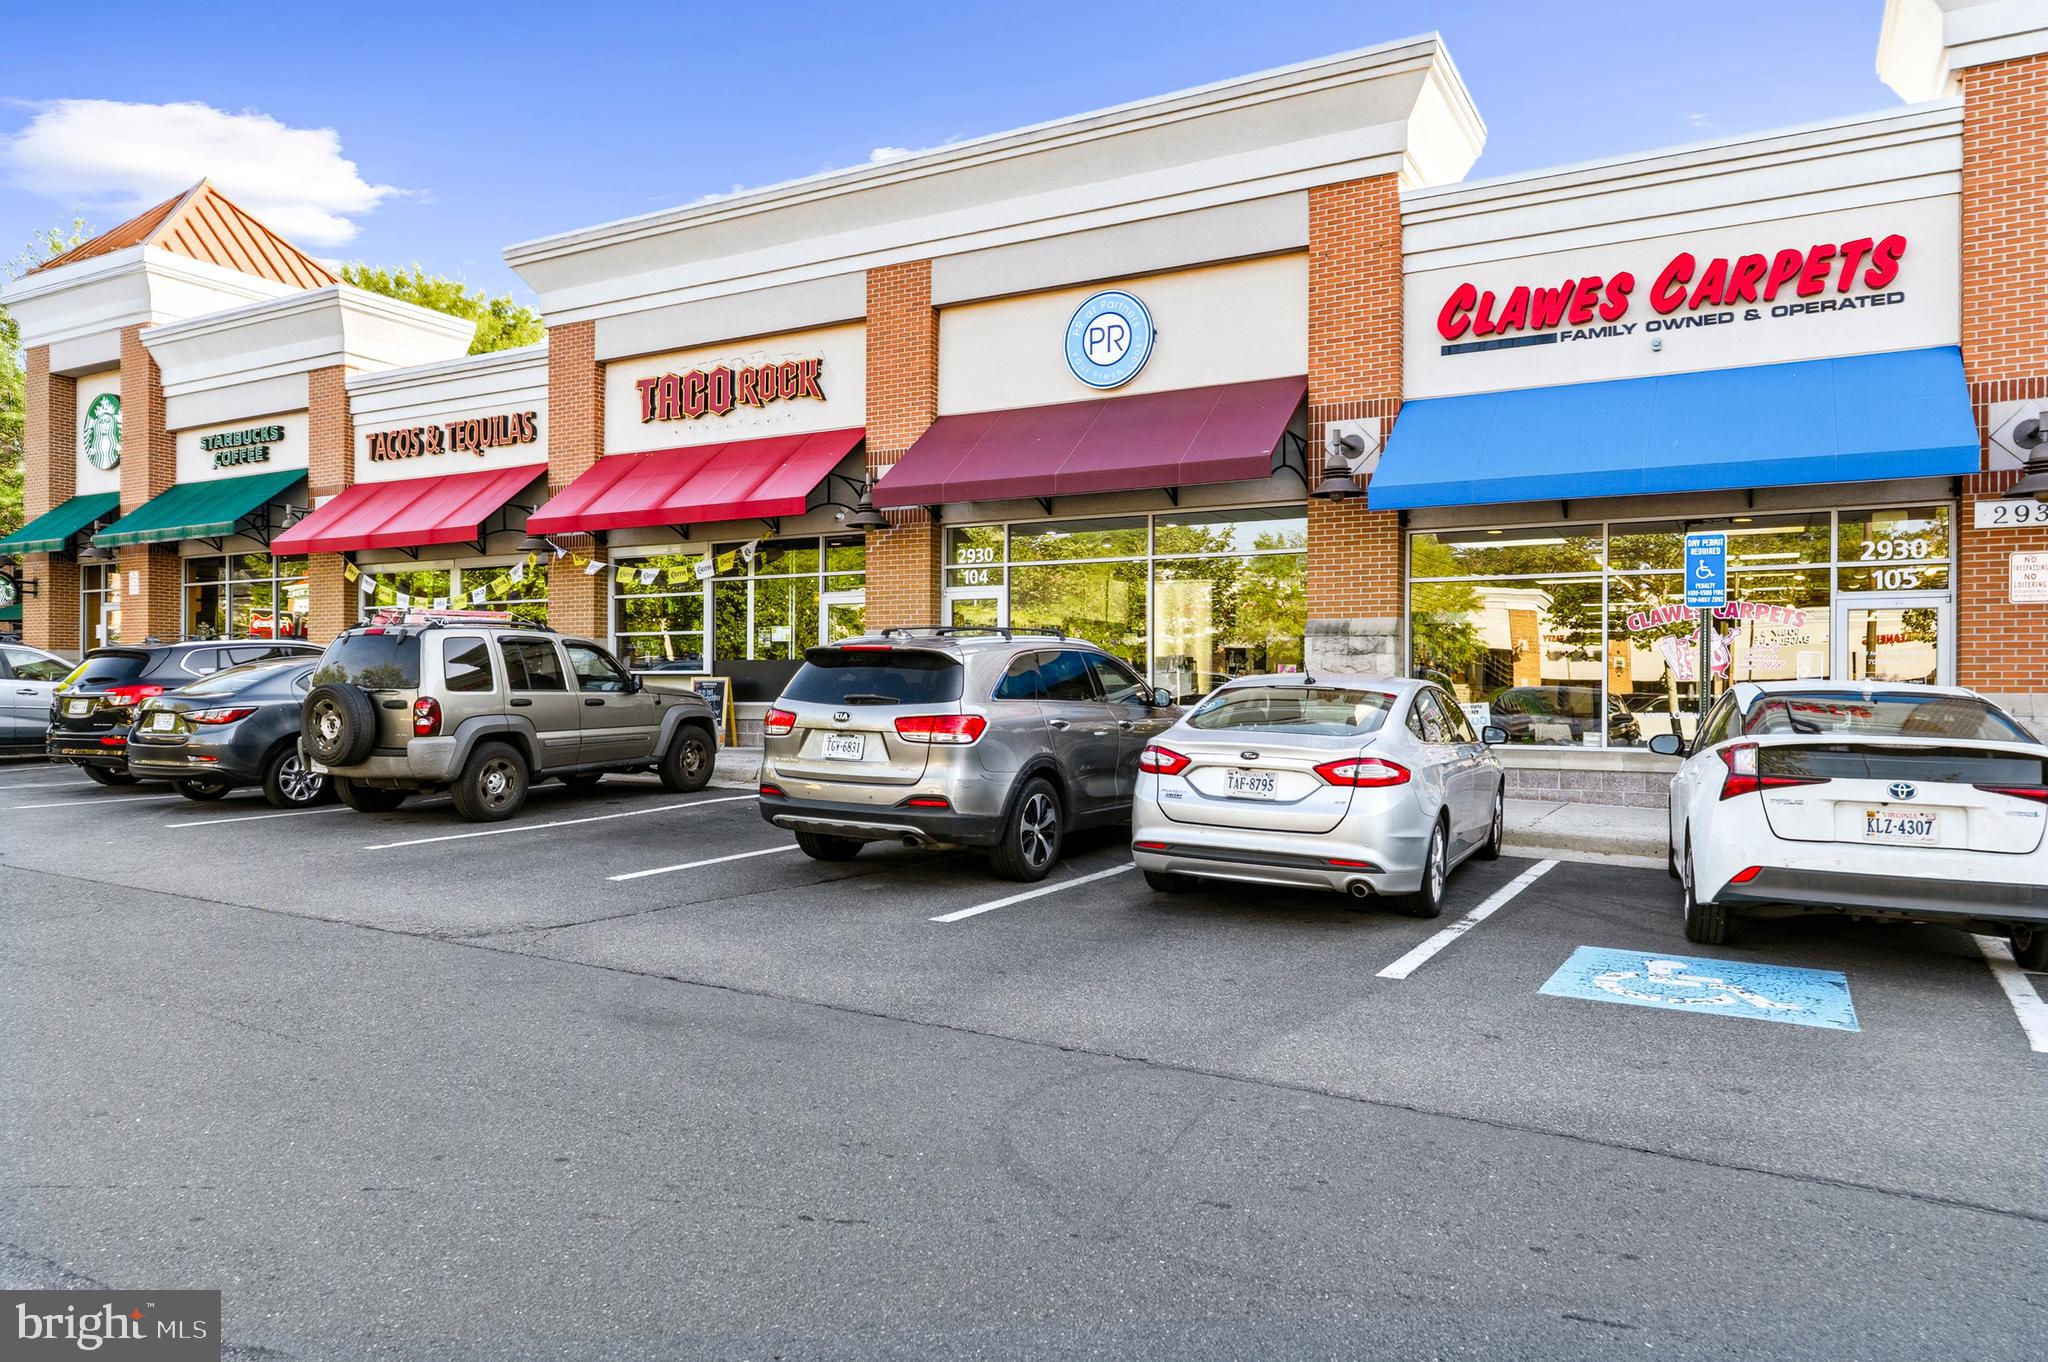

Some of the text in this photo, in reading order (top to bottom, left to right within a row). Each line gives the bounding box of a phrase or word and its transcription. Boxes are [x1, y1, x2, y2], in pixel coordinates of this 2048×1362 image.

[1437, 234, 1907, 340] CLAWES CARPETS
[1560, 291, 1905, 343] FAMILY OWNED & OPERATED
[1090, 324, 1125, 355] PR
[635, 358, 827, 424] TACO ROCK
[200, 425, 284, 451] STARBUCKS
[366, 411, 537, 462] TACOS & TEQUILAS
[212, 446, 270, 469] COFFEE
[957, 547, 994, 564] 2930
[1860, 538, 1928, 561] 2930
[963, 569, 989, 585] 104
[1872, 569, 1919, 590] 105
[834, 712, 850, 720] KIA
[1228, 776, 1274, 791] TAF-8795
[1867, 817, 1933, 835] KLZ-4307
[1882, 811, 1918, 819] VIRGINIA
